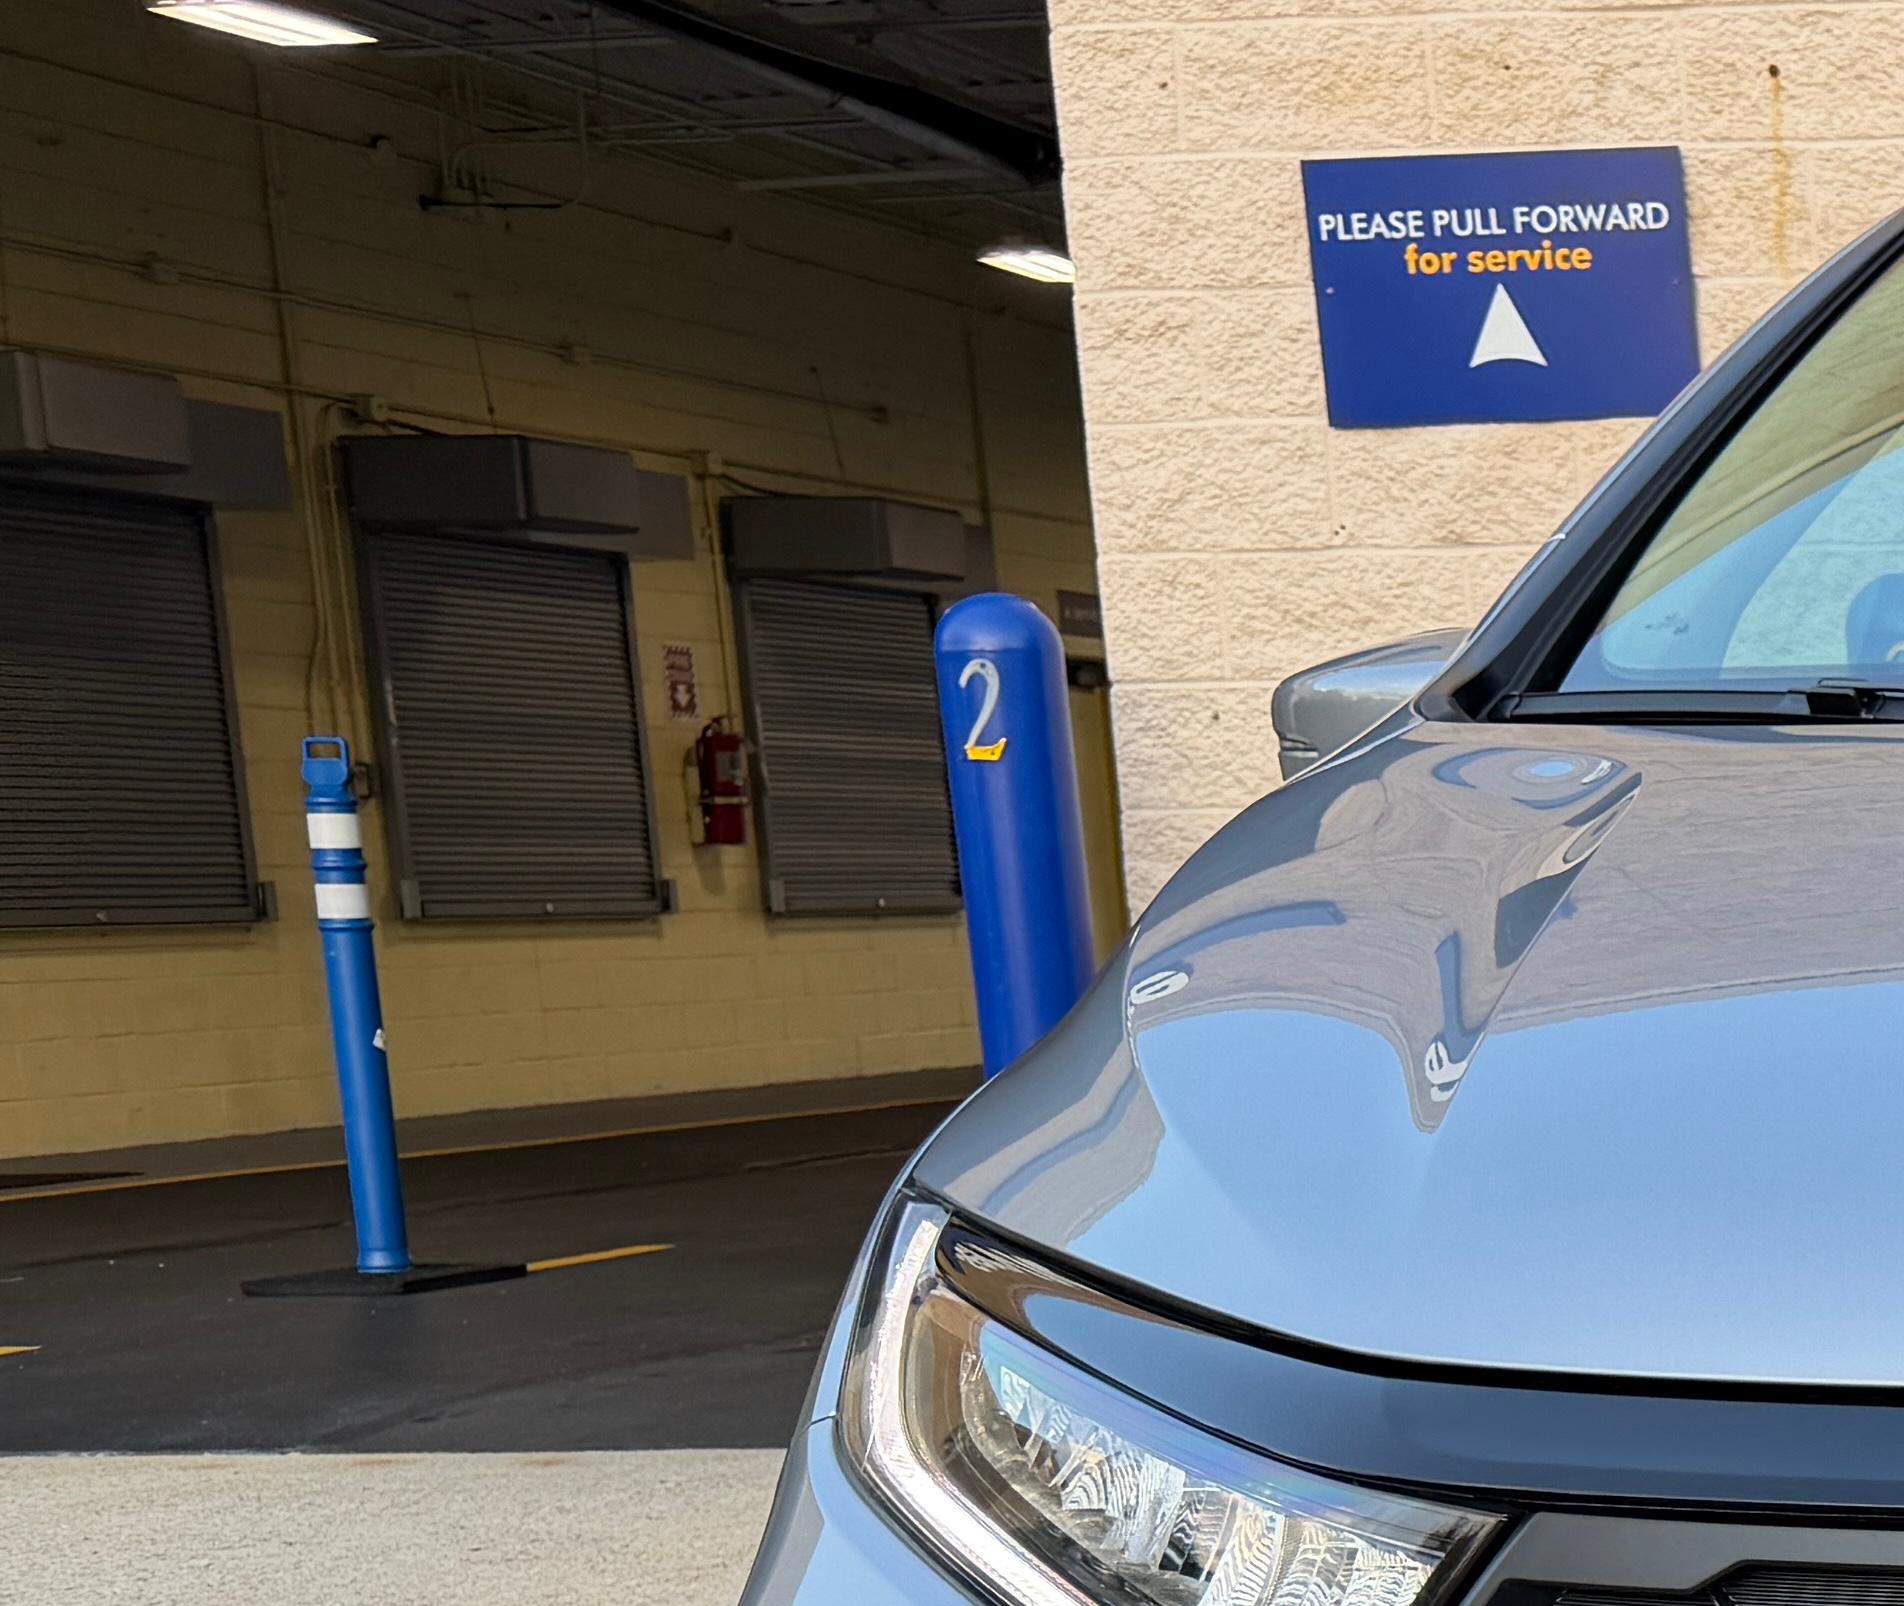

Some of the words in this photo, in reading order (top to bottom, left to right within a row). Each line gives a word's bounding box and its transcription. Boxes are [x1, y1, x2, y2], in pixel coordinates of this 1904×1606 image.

[1318, 210, 1424, 241] PLEASE
[1432, 207, 1506, 237] PULL
[1513, 201, 1669, 234] FORWARD
[1404, 242, 1457, 275] for
[1467, 239, 1592, 274] service
[958, 657, 1007, 762] 2
